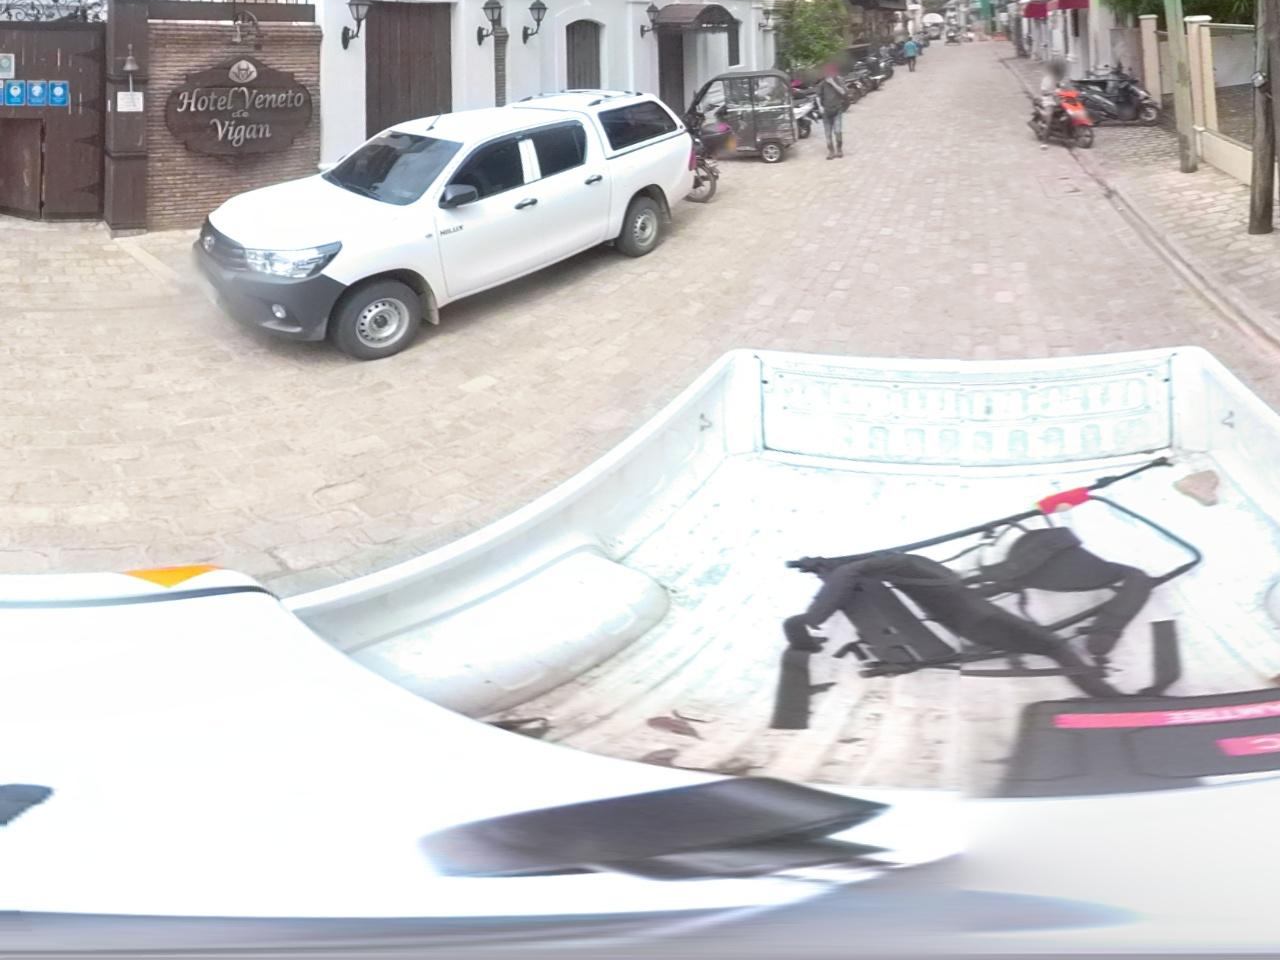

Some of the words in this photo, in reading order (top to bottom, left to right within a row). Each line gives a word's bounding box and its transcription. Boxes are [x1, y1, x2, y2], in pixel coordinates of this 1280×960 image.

[177, 87, 237, 112] Hotel
[237, 86, 304, 110] Veneto
[210, 118, 272, 147] Vigan
